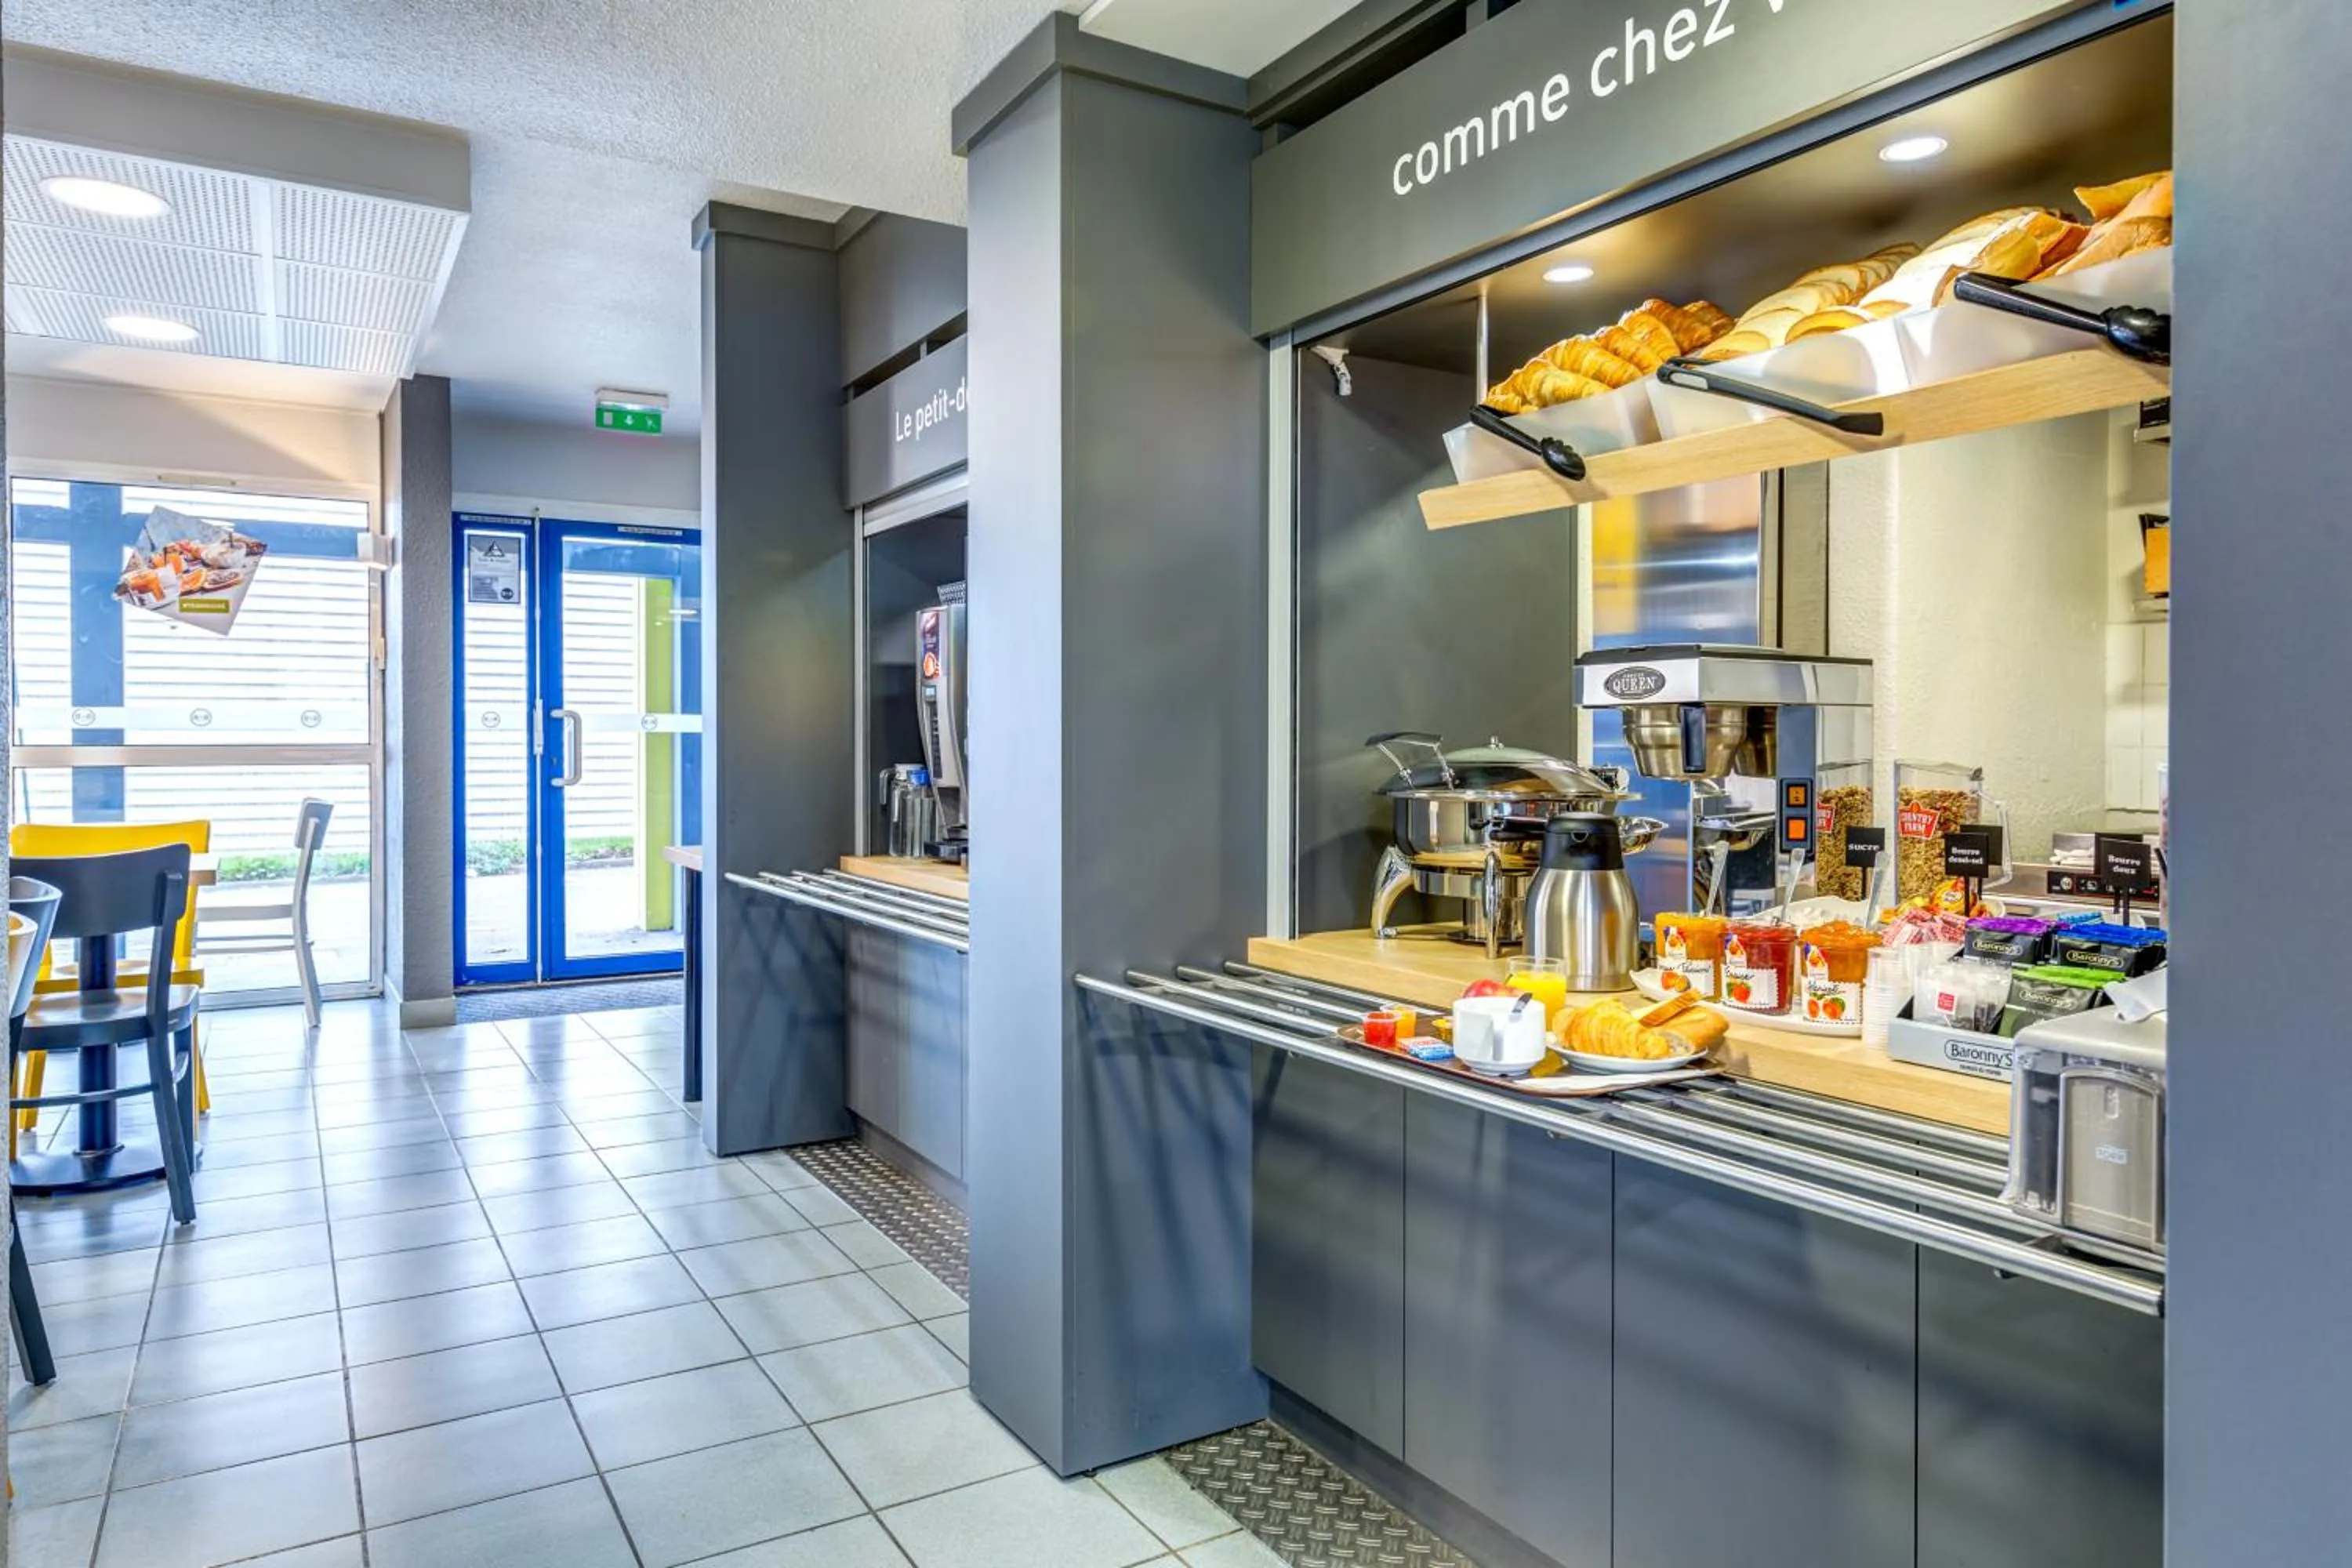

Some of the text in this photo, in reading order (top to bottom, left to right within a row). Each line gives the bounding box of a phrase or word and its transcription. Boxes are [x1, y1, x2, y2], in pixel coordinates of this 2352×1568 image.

[1392, 0, 1735, 195] comme chez
[895, 376, 967, 441] Le petit-d
[1613, 677, 1656, 693] QUEEN
